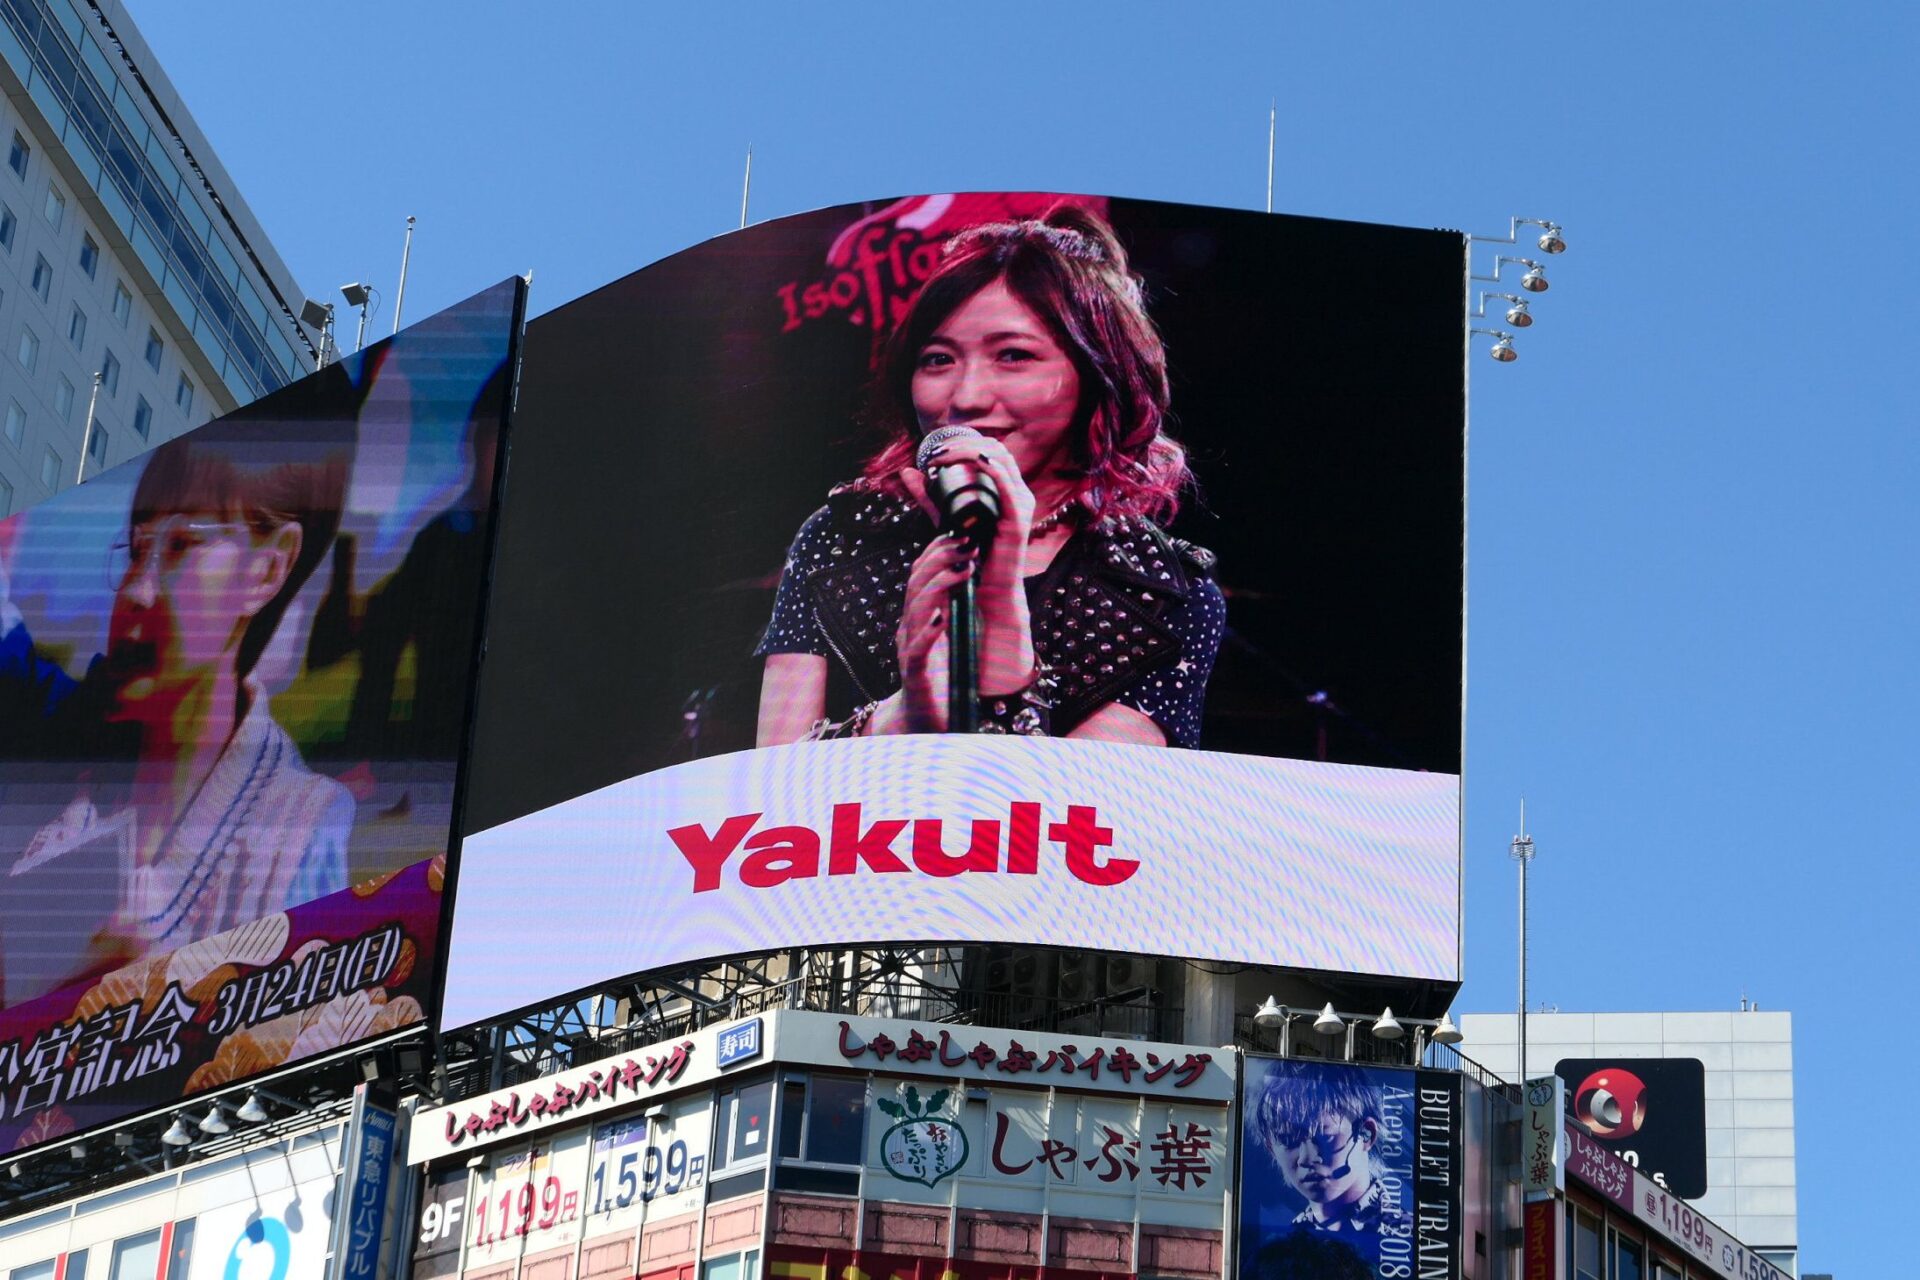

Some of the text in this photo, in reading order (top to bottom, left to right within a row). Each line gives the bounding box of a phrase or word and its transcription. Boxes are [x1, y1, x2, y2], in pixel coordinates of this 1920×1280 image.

[666, 801, 1140, 894] Yakult
[720, 1026, 757, 1059] 寿司
[838, 1020, 1213, 1088] しゃぶしゃぶバイキング
[445, 1040, 696, 1144] しゃぶしゃぶバイキング
[992, 1111, 1212, 1192] しゃぶ葉
[1379, 1082, 1414, 1279] Arena Tour 2018
[1418, 1086, 1451, 1280] BULLET TRAIN
[1530, 1110, 1550, 1185] しゃぶ葉
[1577, 1132, 1628, 1184] しゃぶしゃぶ
[1580, 1161, 1625, 1200] バイキング
[350, 1135, 386, 1277] 東急リバブル
[420, 1197, 465, 1243] 9F
